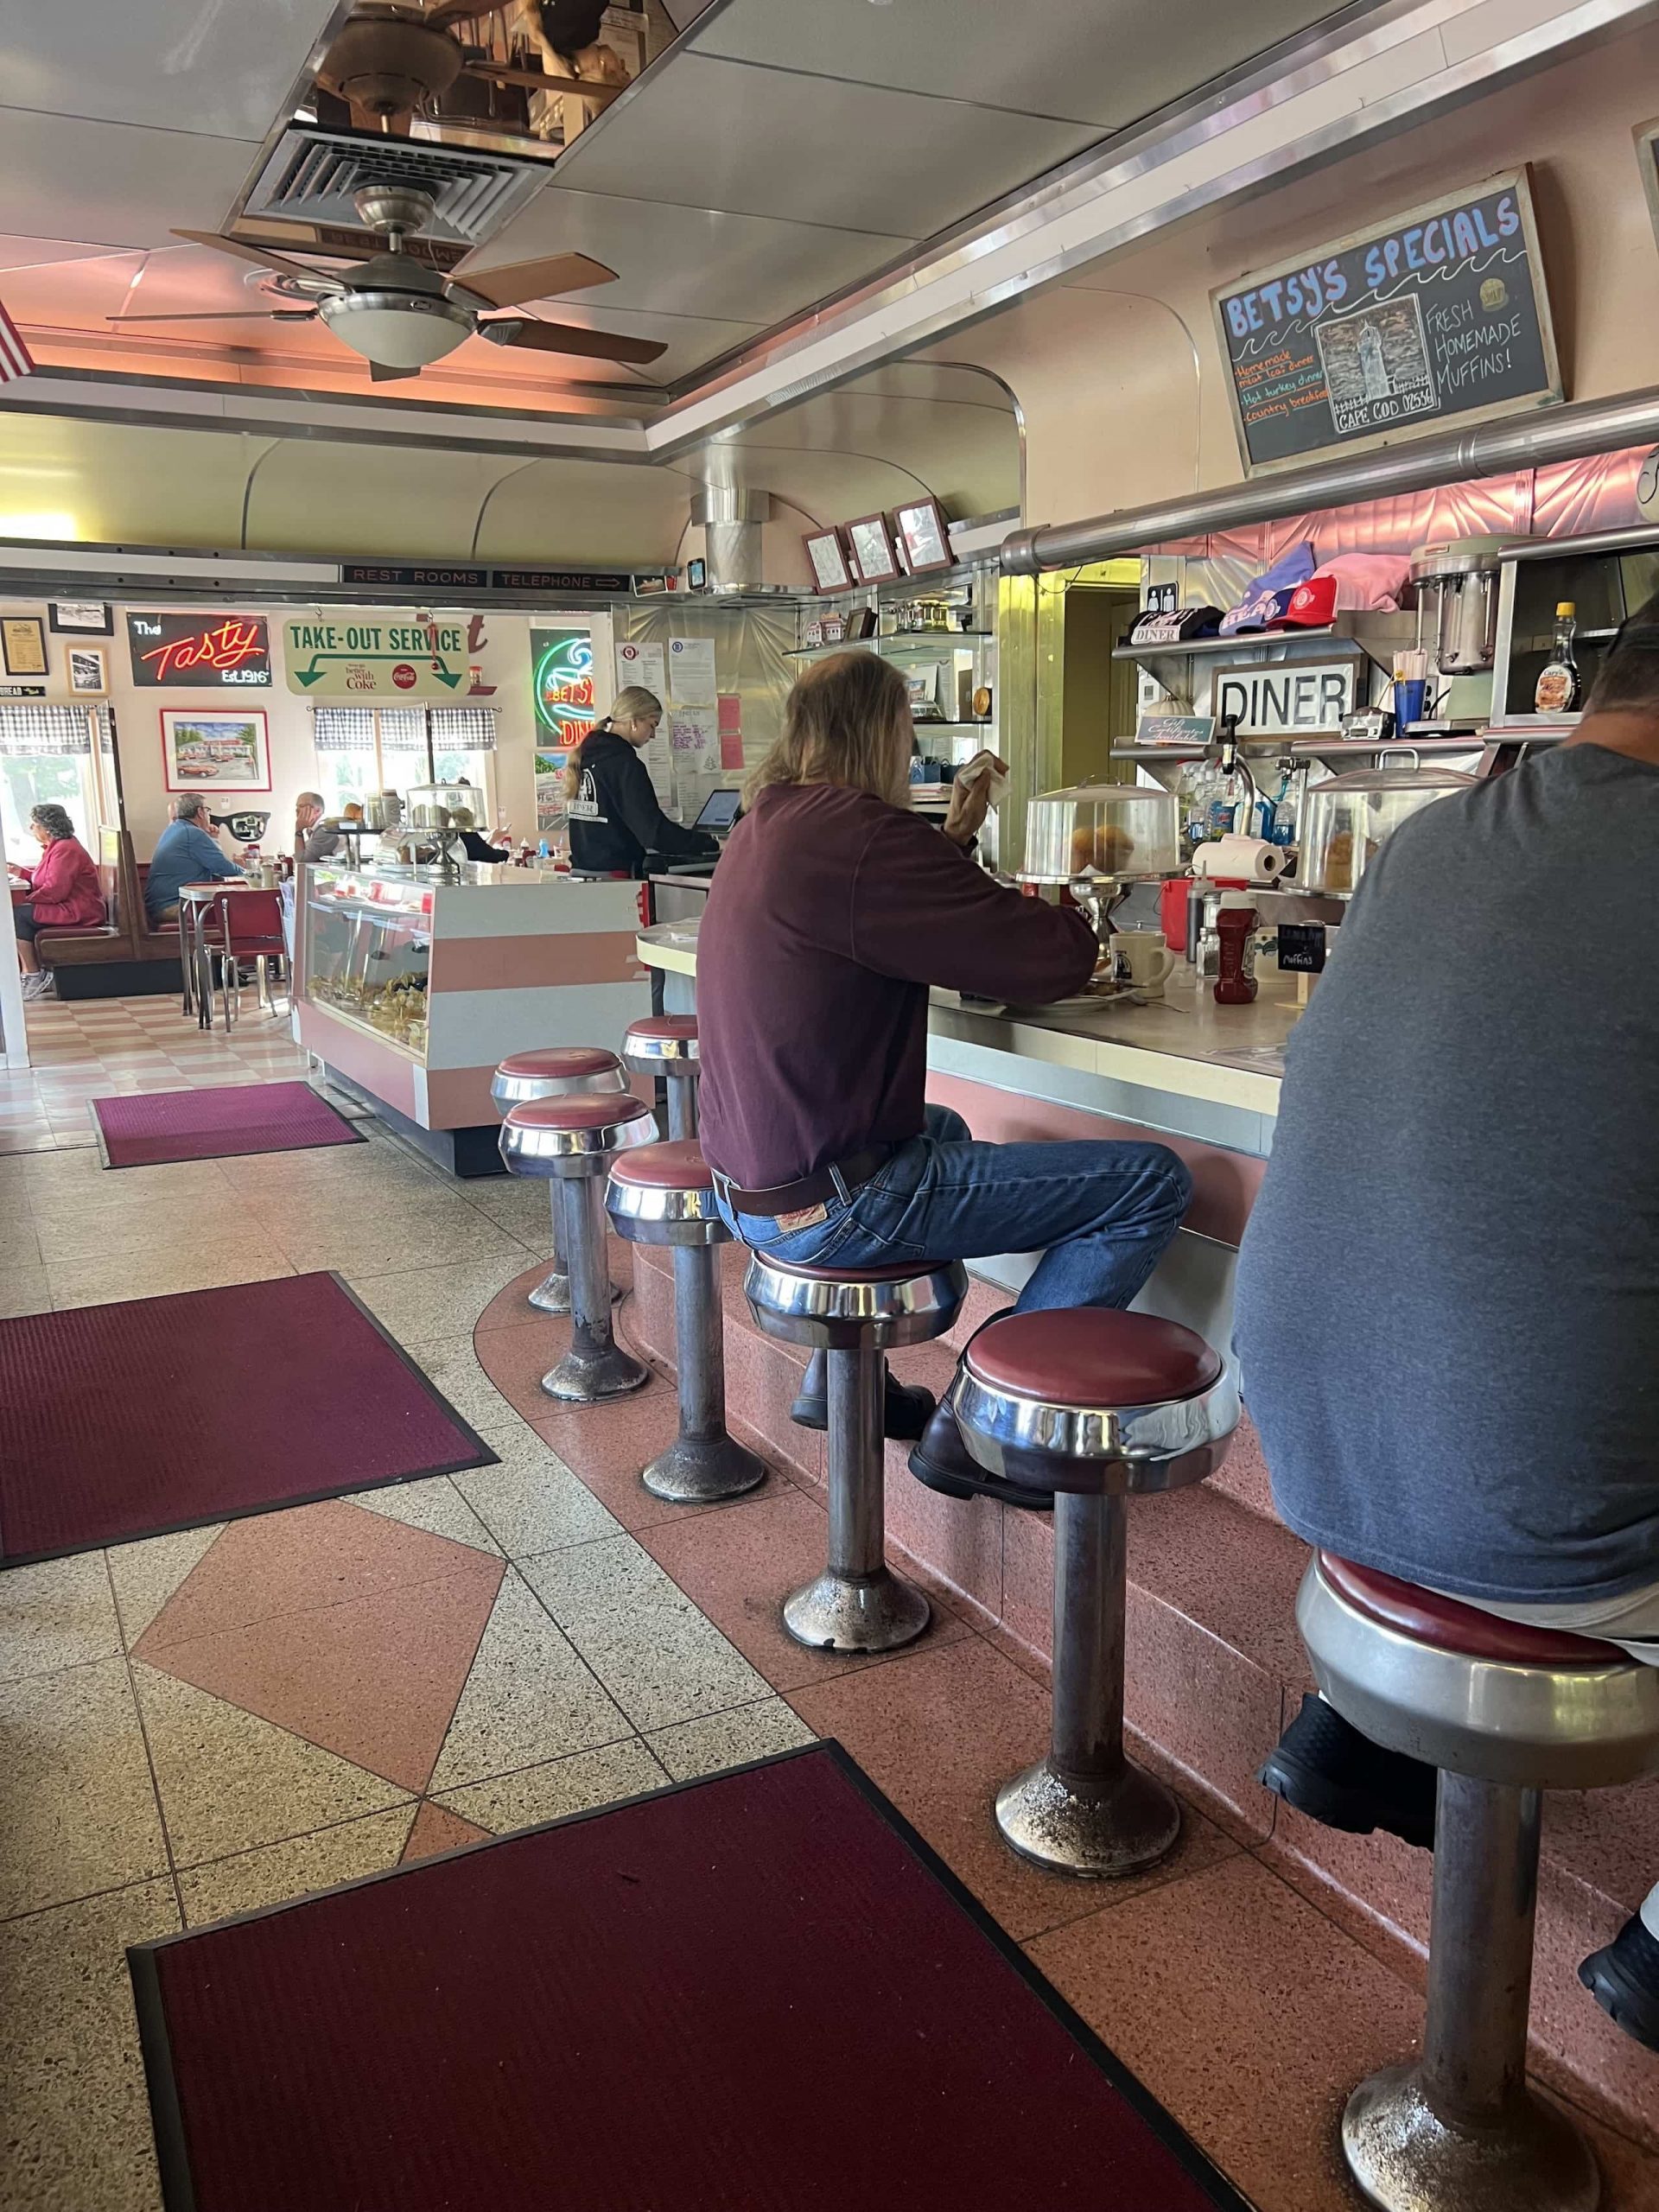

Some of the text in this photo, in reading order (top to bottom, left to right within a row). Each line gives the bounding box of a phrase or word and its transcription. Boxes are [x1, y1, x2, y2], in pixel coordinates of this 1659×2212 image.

[1226, 196, 1519, 338] BETSY'S SPECIALS
[1426, 299, 1474, 334] FRESH
[1434, 313, 1522, 364] HOMEMADE
[1236, 349, 1292, 377] Homemade
[1437, 347, 1511, 395] MUFFINS!
[1243, 391, 1262, 406] Hot
[1338, 388, 1433, 429] CAPE COD 02536
[353, 569, 591, 588] REST ROOMS TELEPHONE
[134, 620, 162, 636] The
[289, 626, 381, 651] TAKE-OUT
[389, 627, 462, 652] SERVICE
[1135, 629, 1175, 640] DINER
[141, 620, 265, 681] Tasty
[346, 677, 377, 690] Coke
[1220, 673, 1346, 728] DINER
